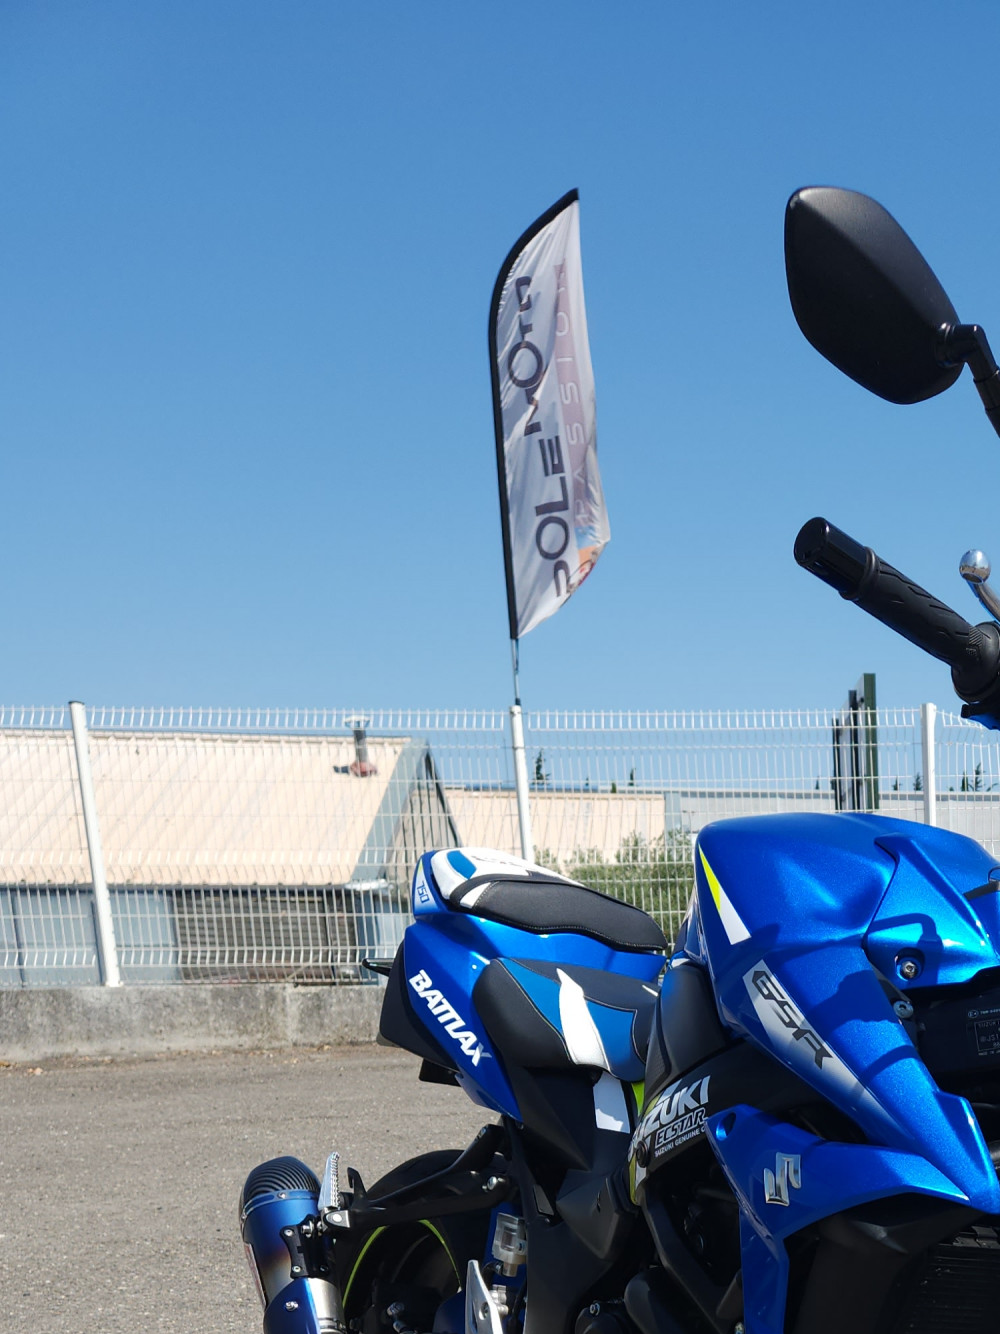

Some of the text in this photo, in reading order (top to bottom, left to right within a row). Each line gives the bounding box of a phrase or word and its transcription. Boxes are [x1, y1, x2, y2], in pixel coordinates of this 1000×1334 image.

[408, 969, 492, 1067] BATTLAX
[654, 1107, 708, 1149] ECSTAR
[675, 1129, 701, 1146] GENUINE
